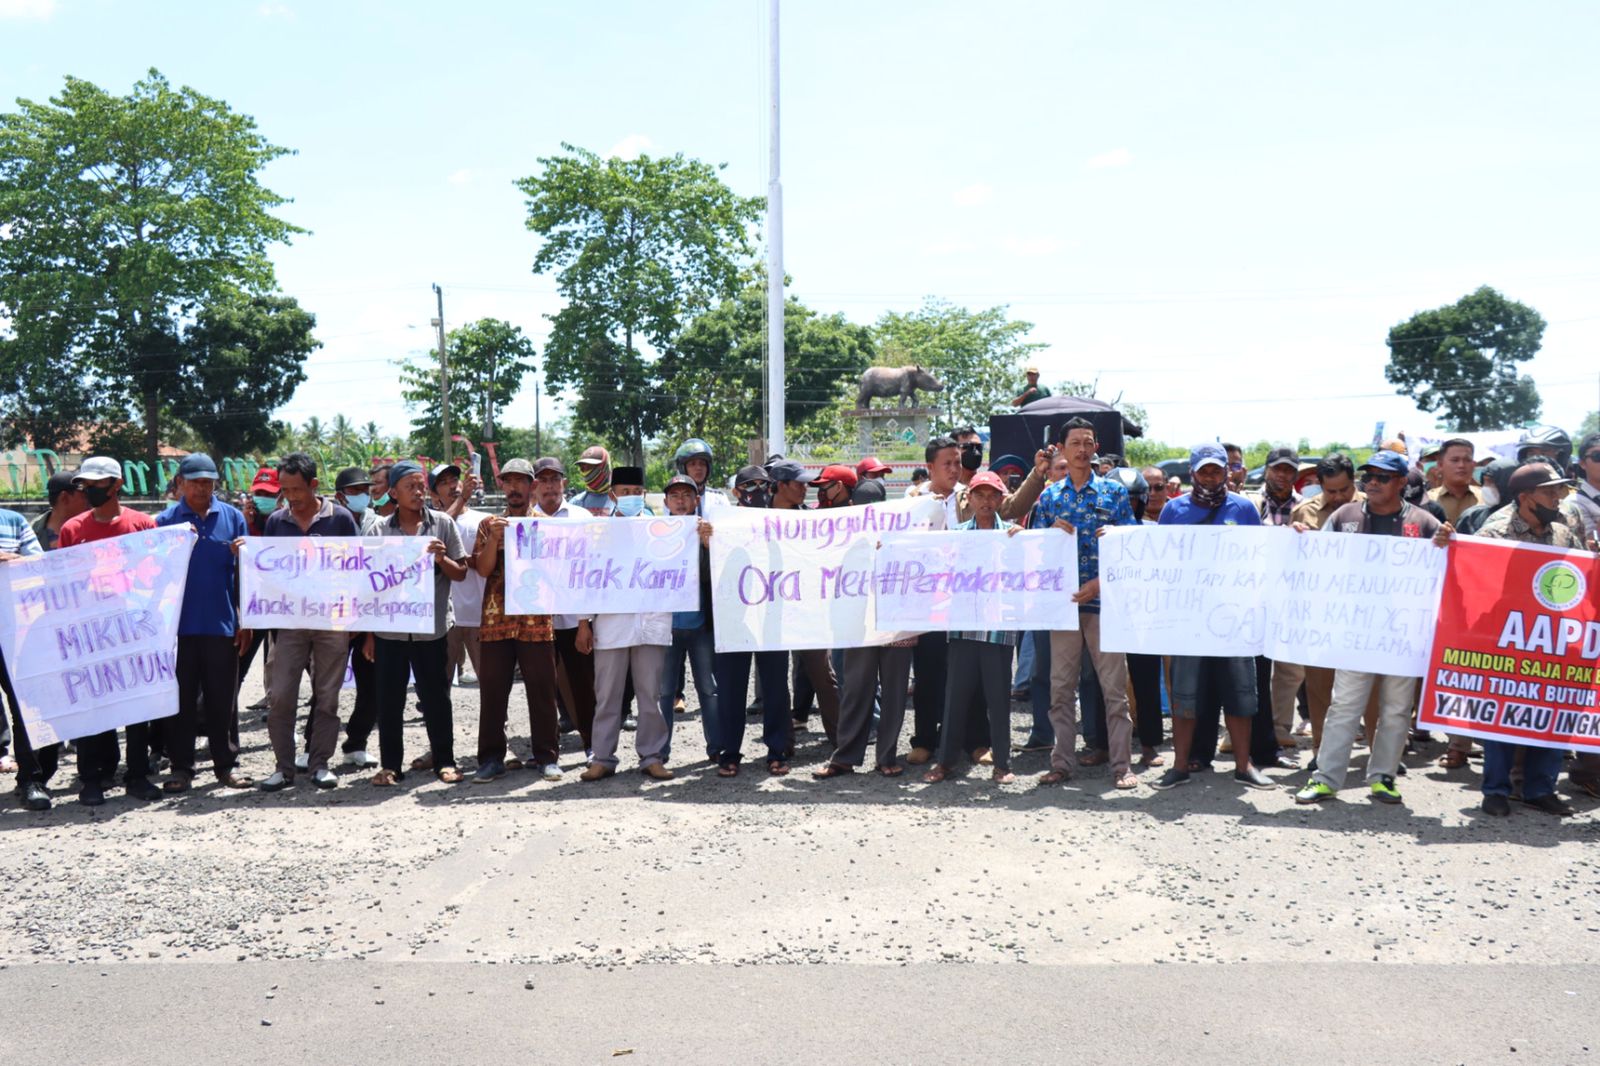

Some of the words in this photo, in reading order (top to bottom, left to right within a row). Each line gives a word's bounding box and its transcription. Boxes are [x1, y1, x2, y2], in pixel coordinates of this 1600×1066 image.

[1116, 531, 1197, 561] KAMI
[1296, 535, 1347, 560] KAMI
[255, 546, 307, 580] Gaji
[317, 546, 373, 571] Tidak
[568, 557, 623, 589] Hak
[629, 557, 688, 590] Kami
[1106, 566, 1142, 583] BUTUH
[1195, 567, 1226, 587] TAPI
[738, 565, 802, 605] Ora
[1276, 568, 1320, 592] MAU
[245, 591, 295, 617] Anak
[1123, 588, 1204, 616] BUTUH
[1324, 601, 1376, 629] KAMI
[55, 609, 158, 661] MIKIR
[1443, 648, 1515, 673] MUNDUR
[1520, 659, 1561, 680] SAJA
[1566, 665, 1594, 684] PAK
[1436, 669, 1483, 692] KAMI
[1489, 676, 1541, 700] TIDAK
[1544, 685, 1597, 707] BUTUH
[1434, 692, 1498, 723] YANG
[1501, 701, 1554, 732] KAU
